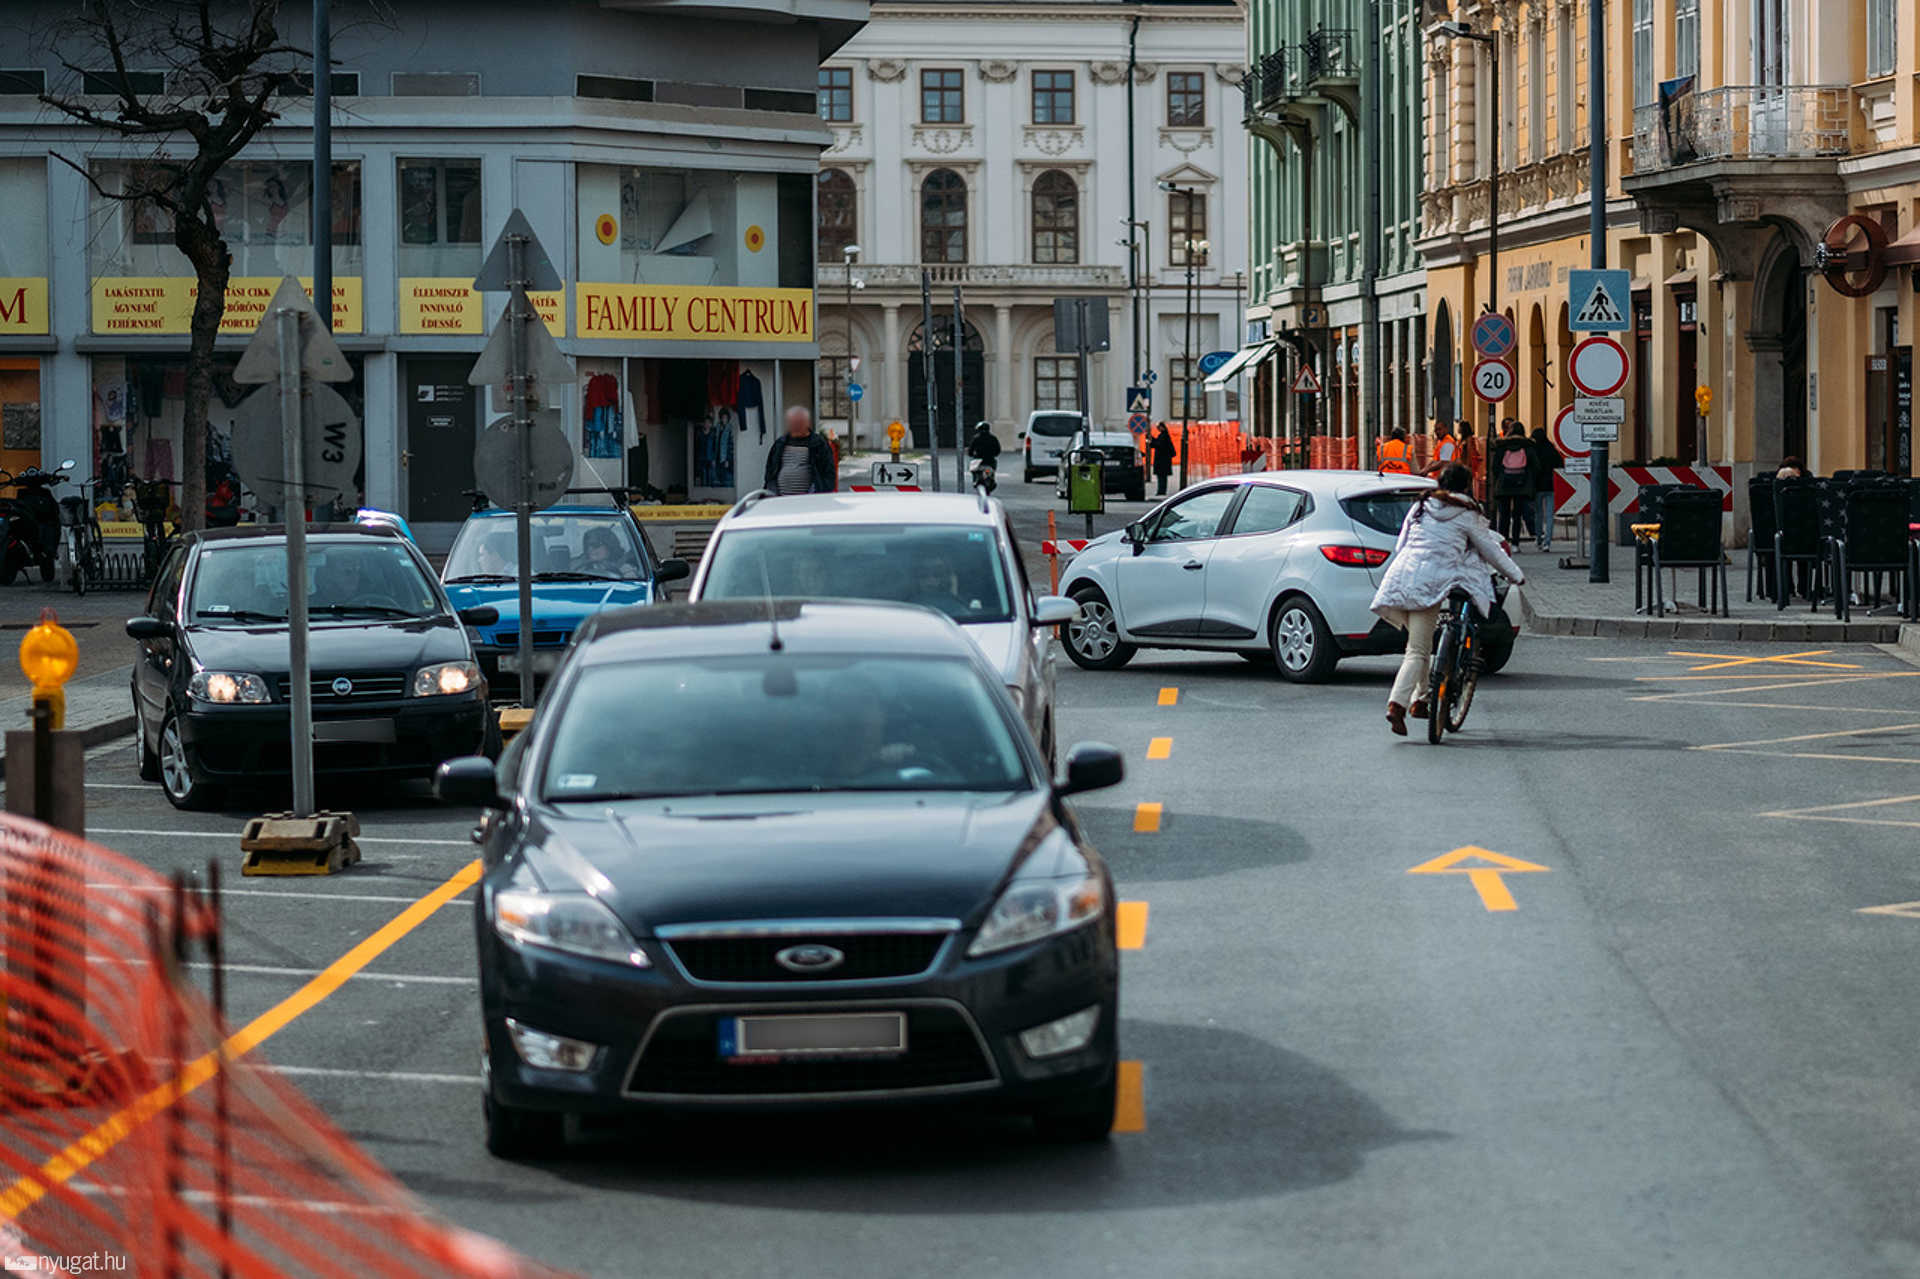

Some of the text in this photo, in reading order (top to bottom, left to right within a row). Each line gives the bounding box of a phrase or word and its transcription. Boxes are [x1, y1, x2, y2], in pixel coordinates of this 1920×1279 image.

[105, 286, 165, 297] LAKÁSTEXTIL
[247, 287, 271, 297] CIKK
[413, 287, 470, 298] ÉLELMISZER
[419, 302, 464, 313] INNIVALÓ
[585, 294, 809, 335] FAMILY CENTRUM
[421, 317, 463, 329] ÉDESSÉG
[1483, 372, 1504, 389] 20
[322, 422, 347, 463] W3
